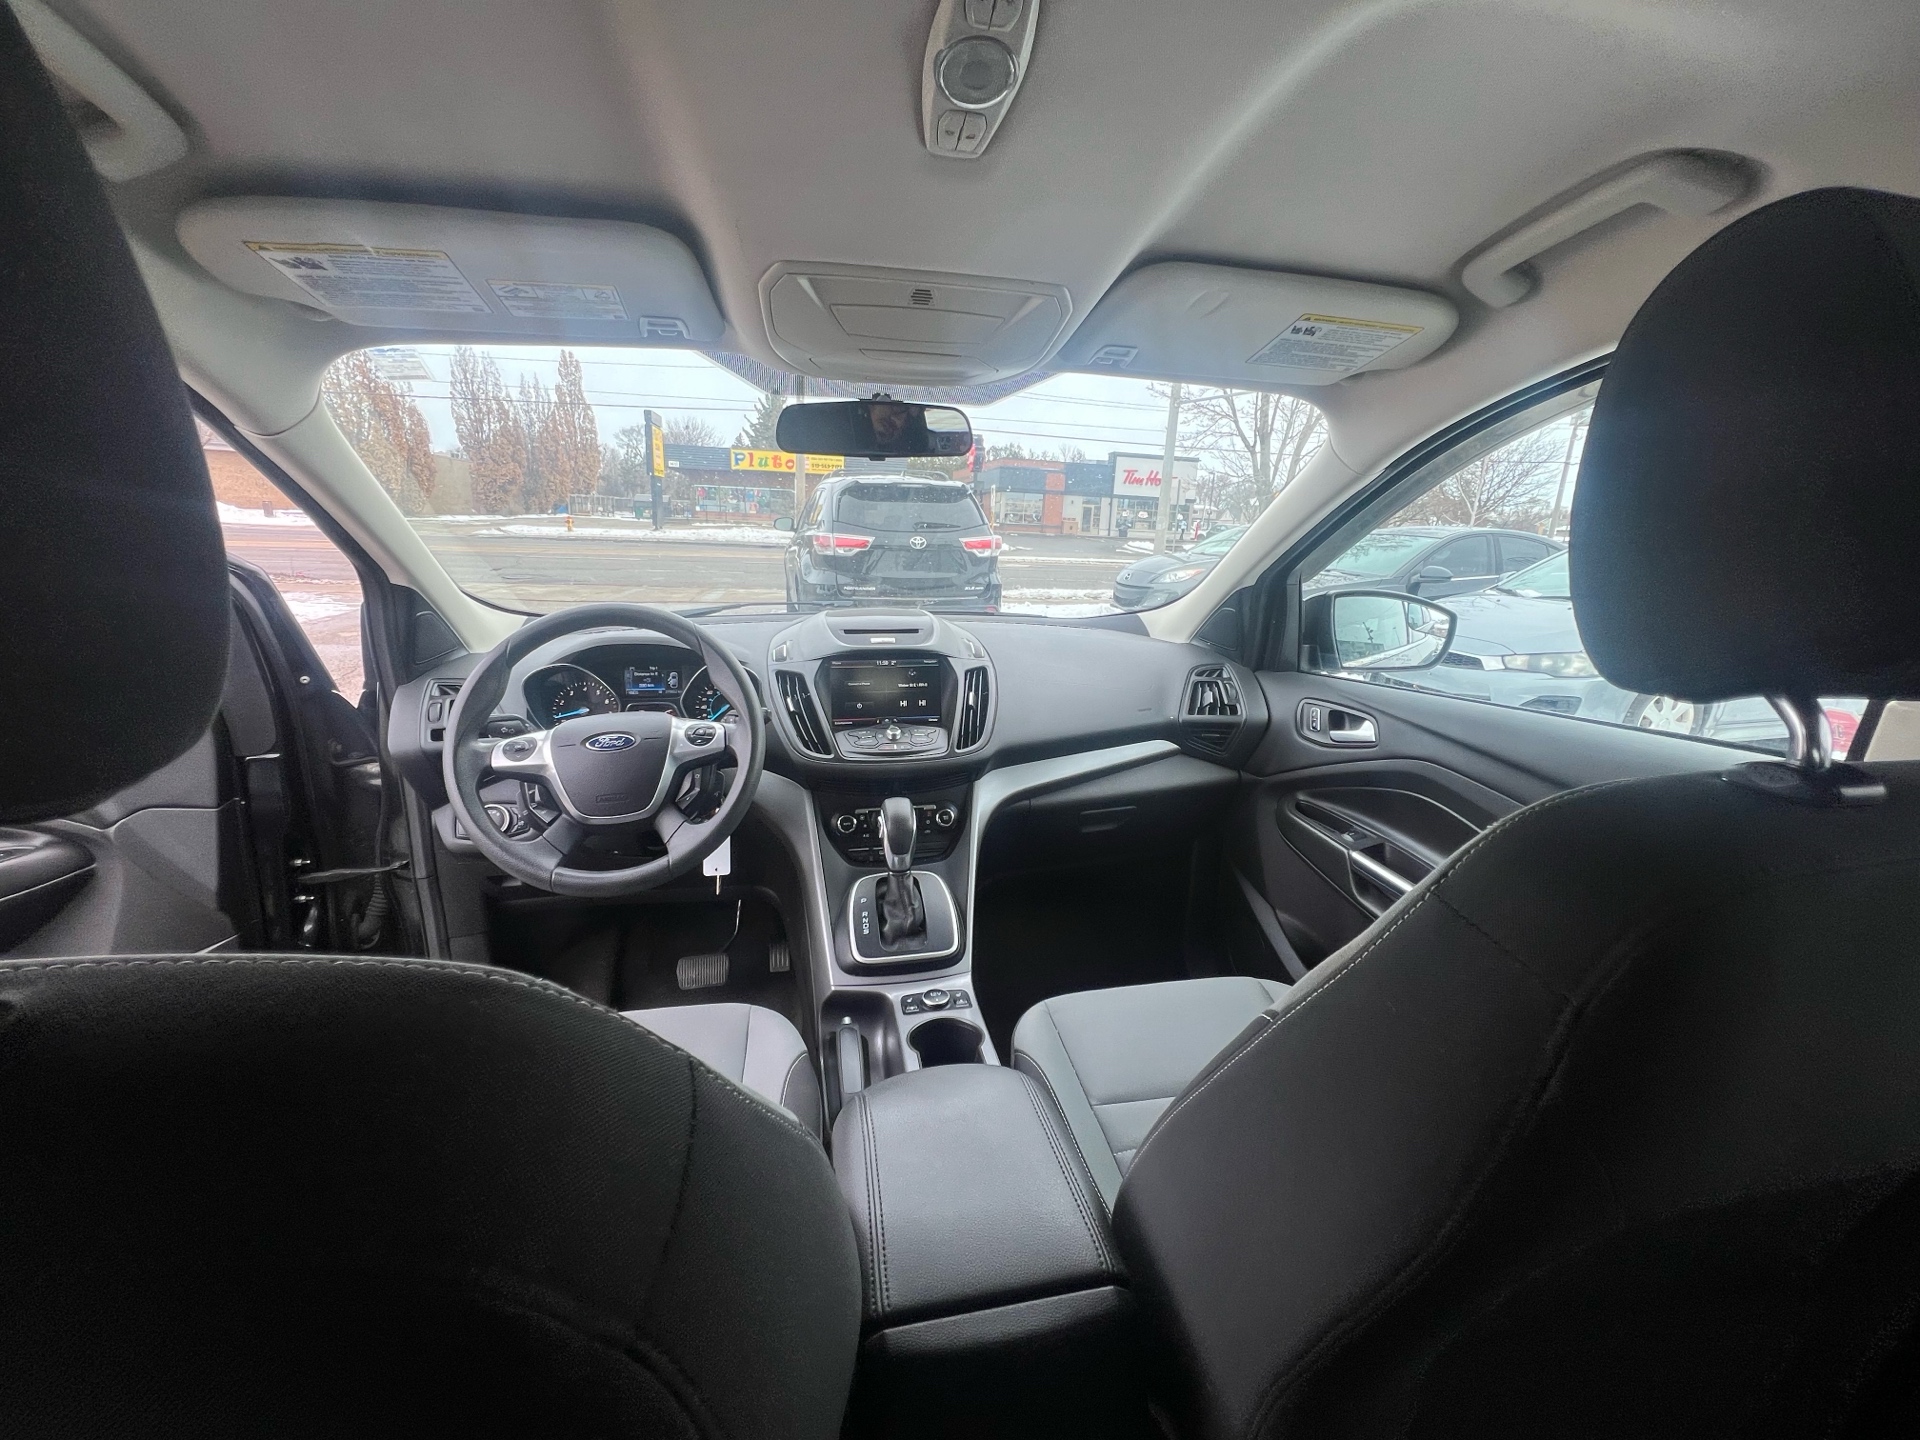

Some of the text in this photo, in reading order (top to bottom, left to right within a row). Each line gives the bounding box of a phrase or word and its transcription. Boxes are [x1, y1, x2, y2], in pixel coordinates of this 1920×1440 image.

[733, 451, 795, 470] Pluto
[1123, 469, 1144, 486] Tim
[594, 735, 625, 749] Ford
